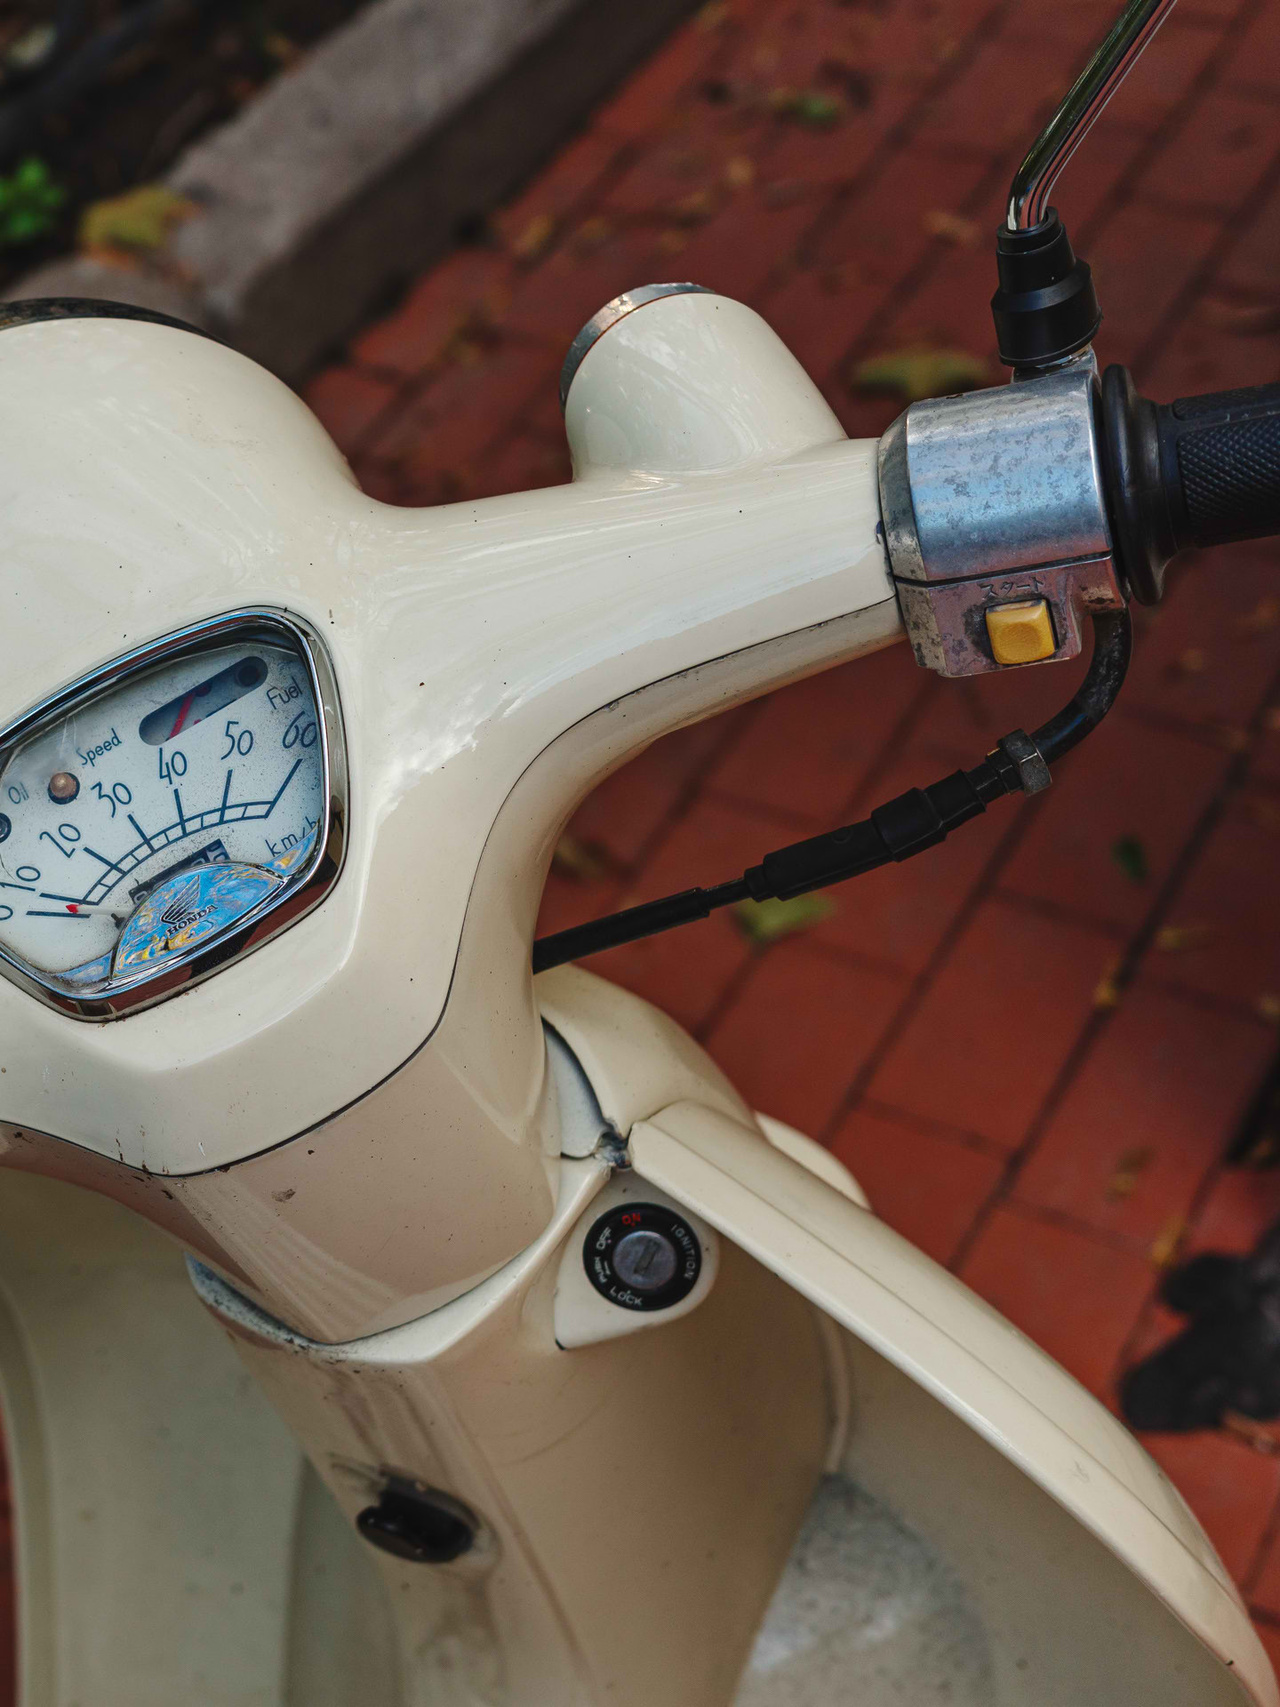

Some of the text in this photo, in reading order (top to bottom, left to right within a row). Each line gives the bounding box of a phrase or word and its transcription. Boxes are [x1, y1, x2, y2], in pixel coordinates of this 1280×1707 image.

[979, 575, 1046, 599] スタート
[266, 675, 303, 710] Fuel
[76, 727, 123, 767] Speed
[220, 720, 254, 760] 50
[282, 710, 318, 749] 60
[158, 747, 188, 785] 40
[8, 781, 29, 805] Oil
[90, 781, 133, 818] 30
[39, 822, 81, 859] 20
[166, 904, 219, 937] HONDA
[622, 1212, 641, 1226] ON
[595, 1226, 612, 1251] OFF
[670, 1223, 697, 1281] IGNITION
[609, 1286, 643, 1306] LOCK
